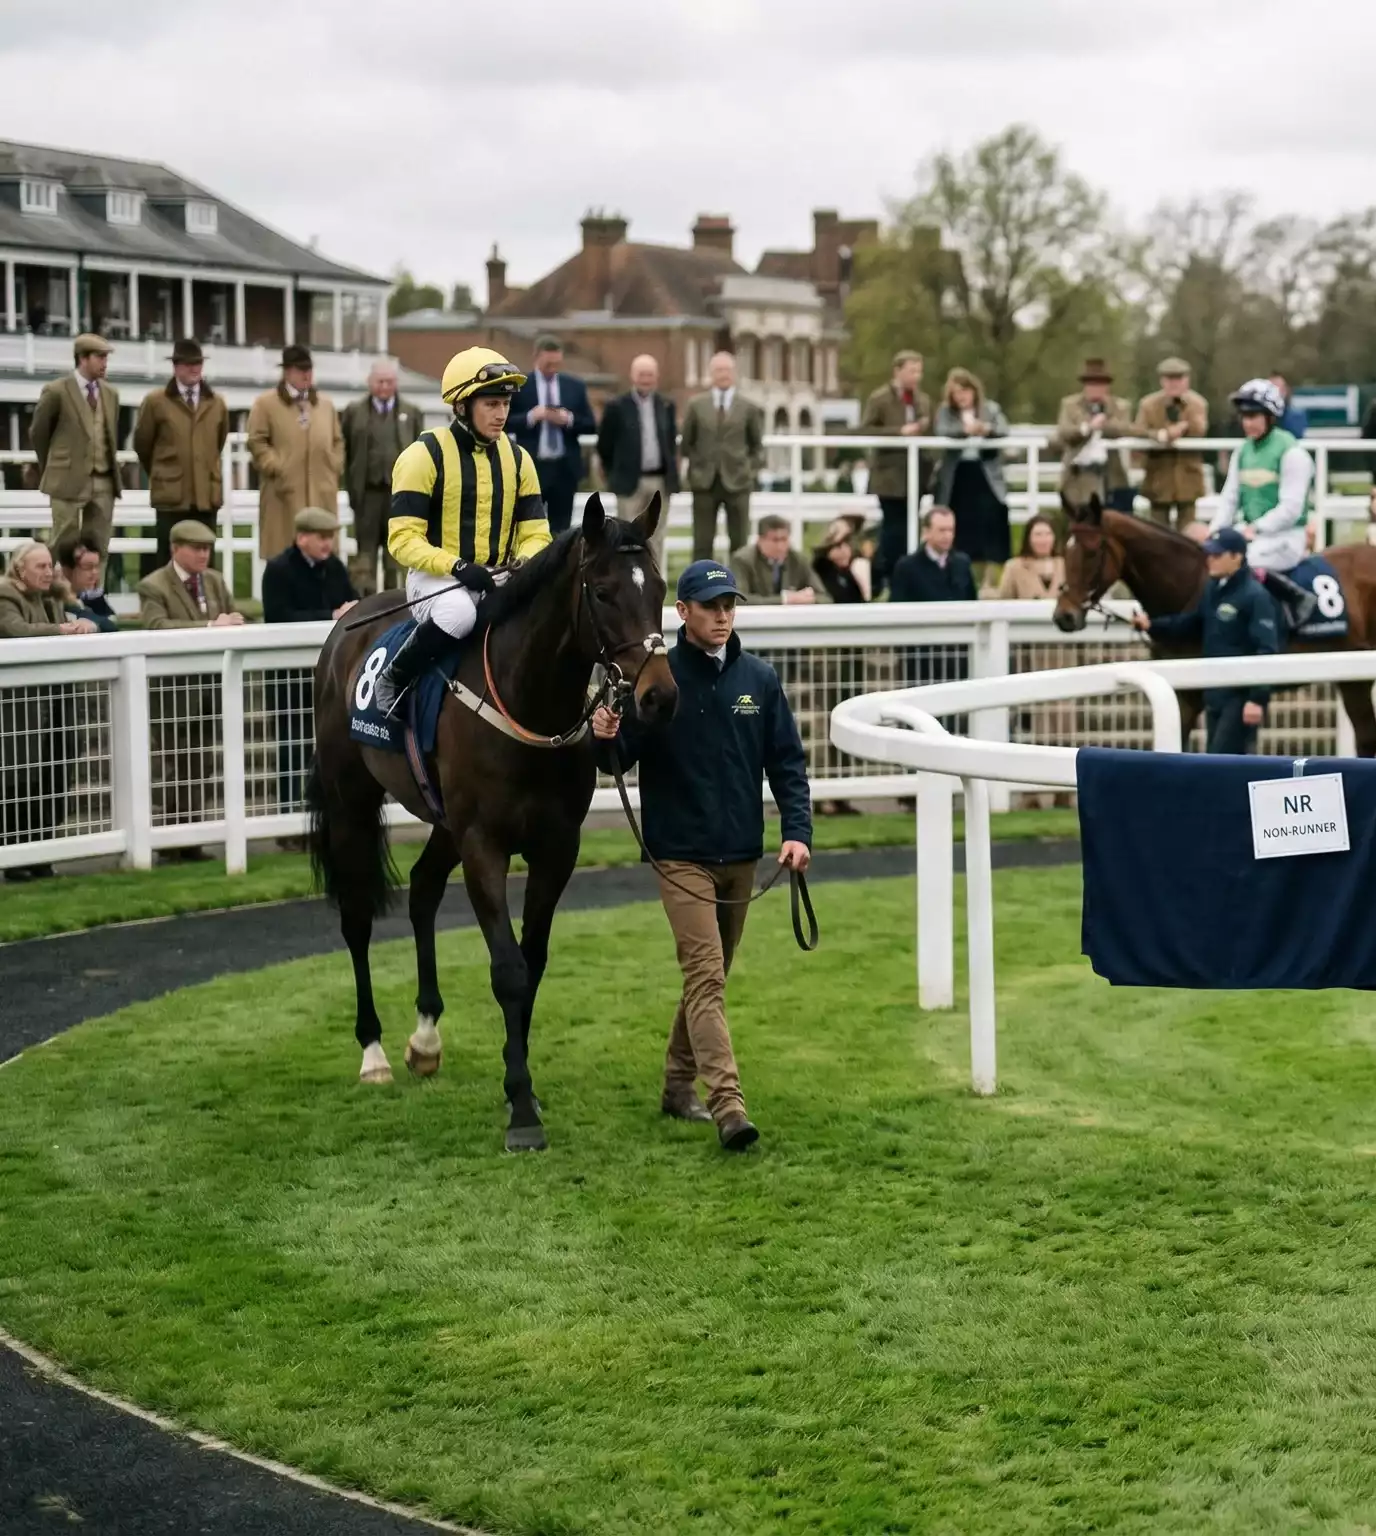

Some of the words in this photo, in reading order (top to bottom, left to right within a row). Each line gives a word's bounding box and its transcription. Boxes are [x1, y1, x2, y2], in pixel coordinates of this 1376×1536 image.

[1312, 574, 1345, 618] 8
[355, 646, 388, 711] 8
[1283, 794, 1313, 815] NR
[1263, 822, 1337, 839] NON-RUNNER
